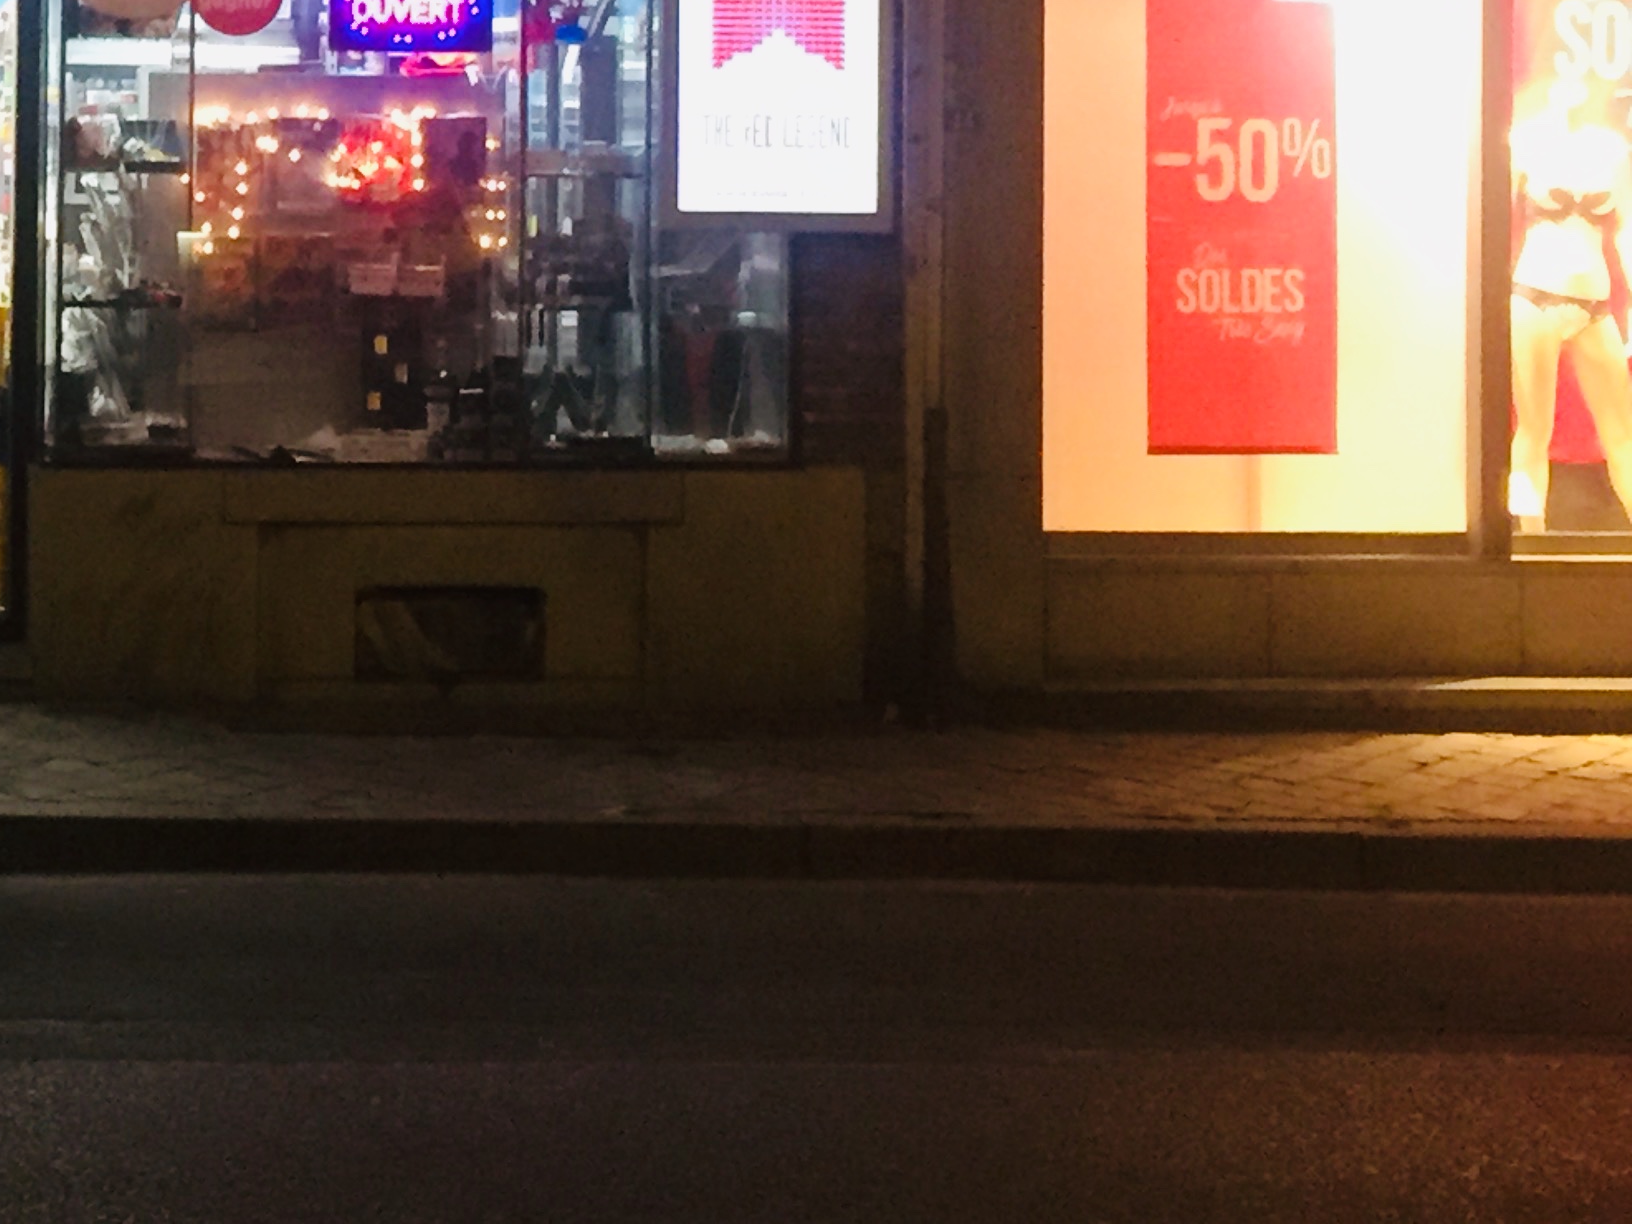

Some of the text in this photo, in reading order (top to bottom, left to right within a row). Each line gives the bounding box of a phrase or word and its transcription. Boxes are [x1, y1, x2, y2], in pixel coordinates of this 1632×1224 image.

[782, 113, 852, 150] LEEND
[1152, 117, 1332, 203] -50%
[1175, 268, 1305, 314] SOLDES
